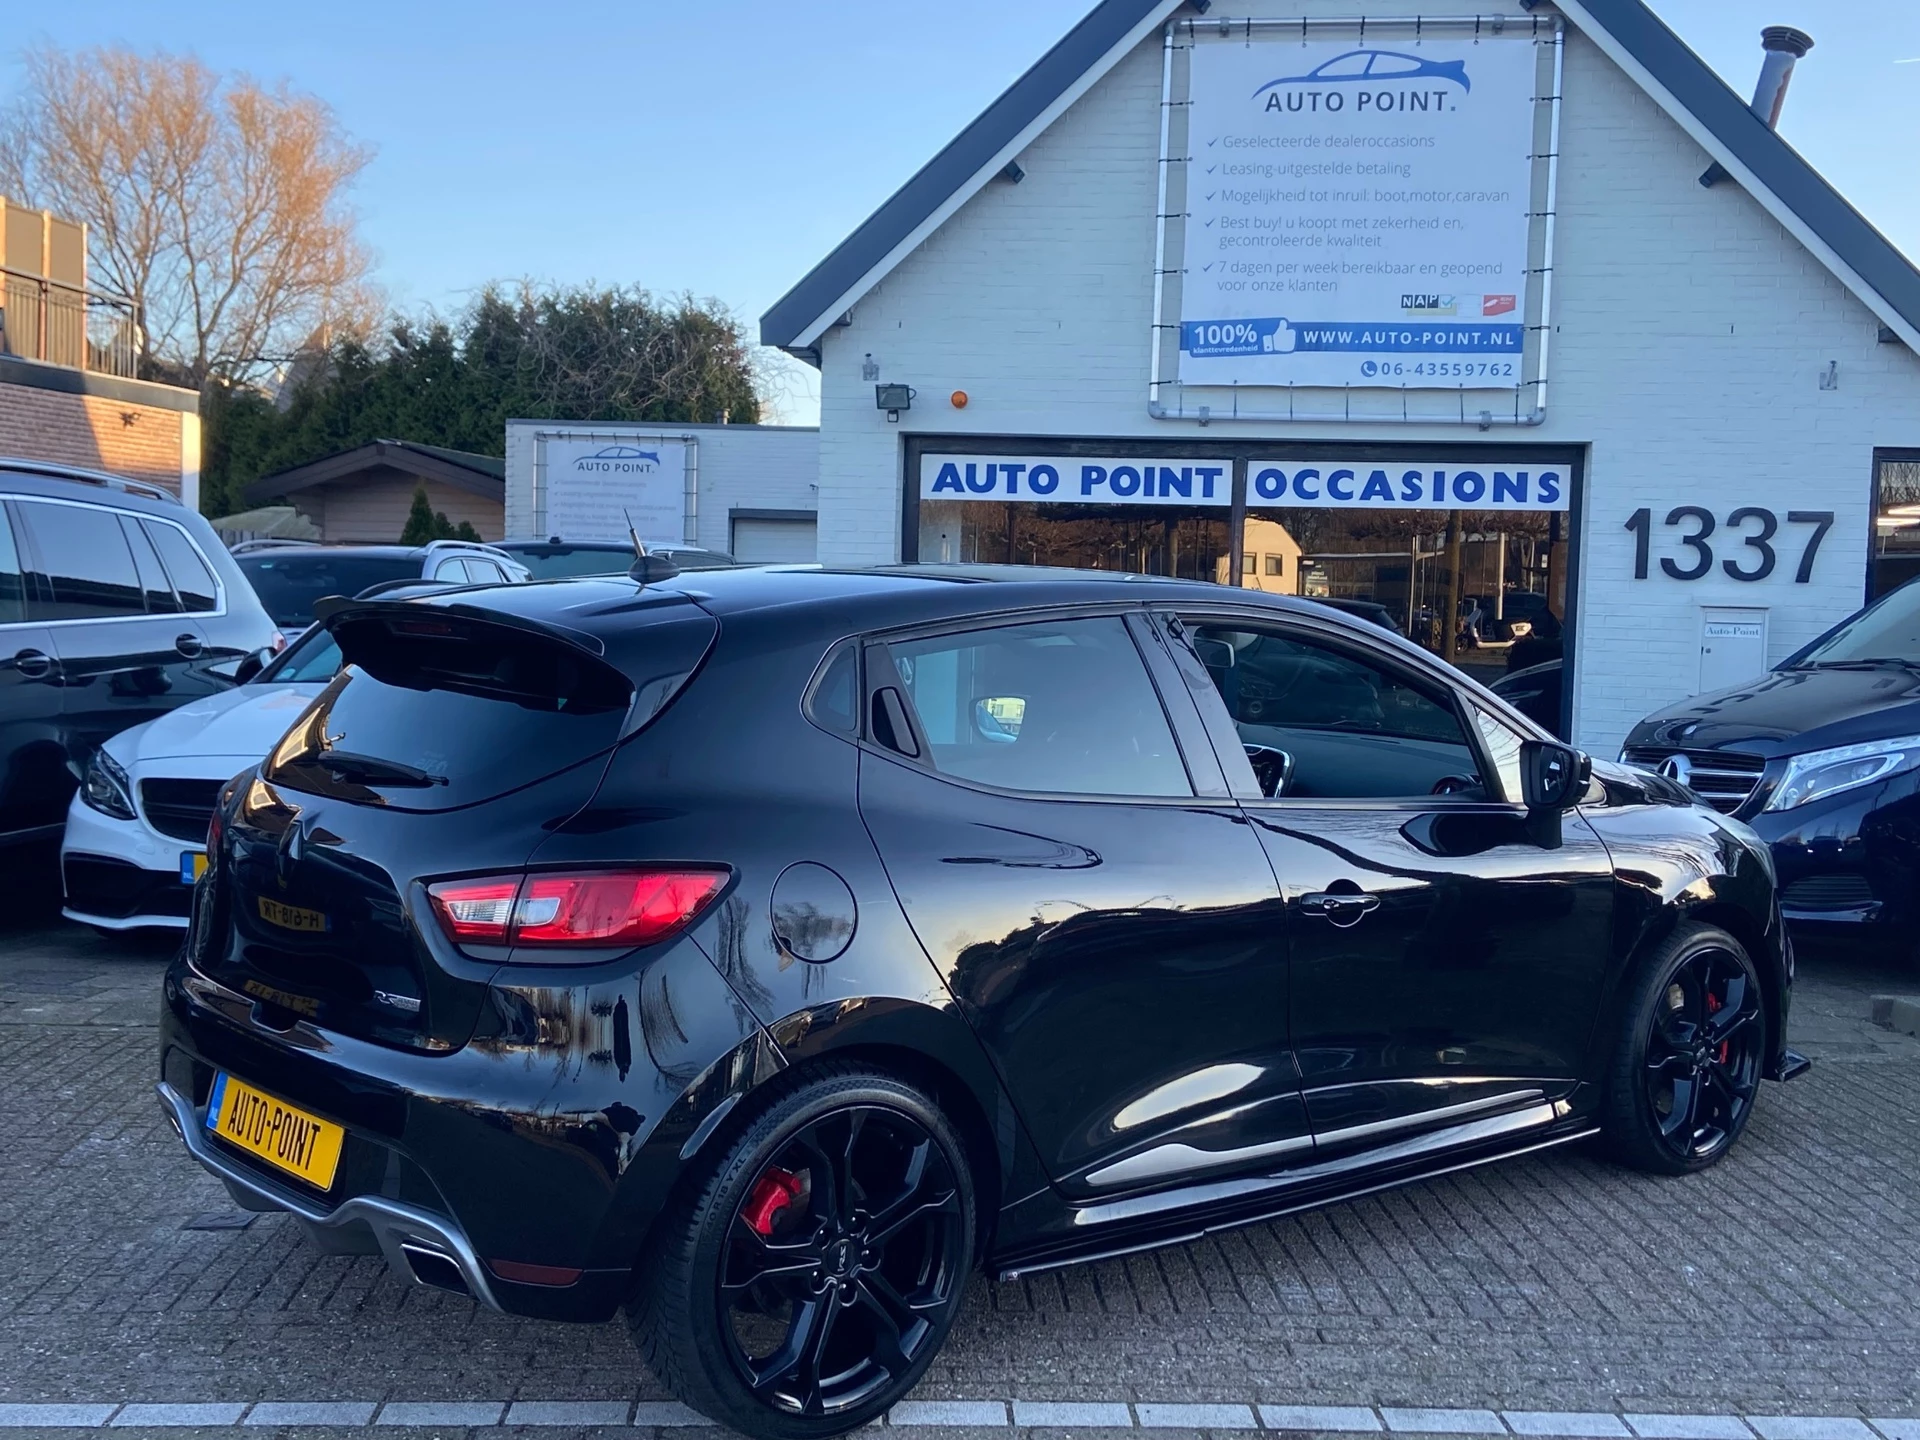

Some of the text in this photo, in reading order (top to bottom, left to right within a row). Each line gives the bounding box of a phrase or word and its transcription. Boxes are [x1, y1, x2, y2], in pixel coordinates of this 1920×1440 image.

[1265, 91, 1345, 112] AUTO
[1223, 134, 1435, 148] Geselecteerde dealeroccasions
[1222, 161, 1411, 179] Leasing-uitgestelde betaling
[1221, 188, 1306, 206] Mogelijkheid
[1310, 189, 1328, 202] tot
[1220, 216, 1464, 232] Best buy! u koopt met zekerheid en,
[1219, 234, 1382, 250] gecontroleerde kwaliteit
[1219, 260, 1503, 278] 7 dagen per week bereikbaar en geopend
[1217, 278, 1338, 292] voor onze klanten
[1402, 294, 1438, 308] NAP
[1194, 323, 1258, 345] 100%
[1303, 329, 1515, 346] WWW.AUTO-POINT.NL
[1381, 361, 1513, 377] 06-43559762
[577, 462, 610, 472] AUTO
[931, 462, 1561, 503] AUTO POINT OCCASIONS
[1624, 505, 1835, 583] 1337
[1706, 626, 1760, 636] Auto-Point
[227, 1088, 322, 1171] AUTO-POINT
